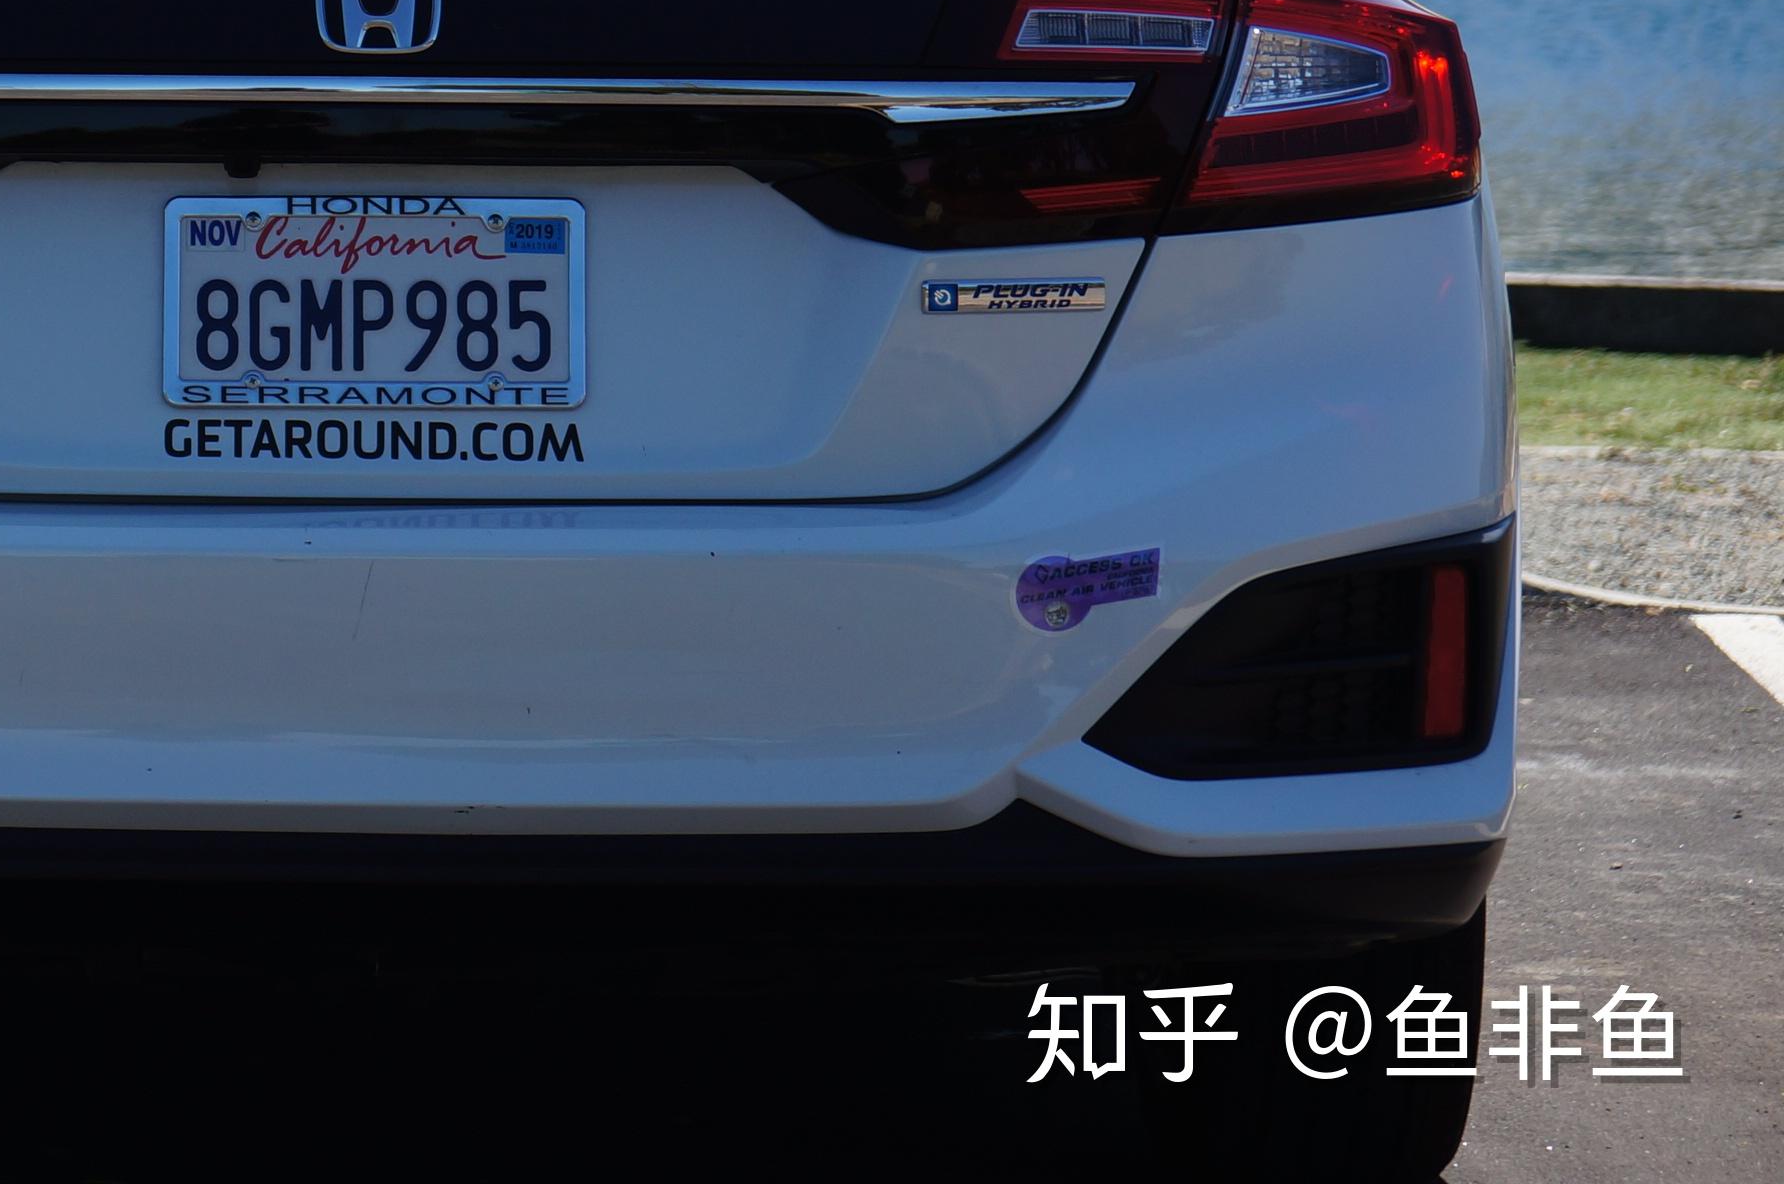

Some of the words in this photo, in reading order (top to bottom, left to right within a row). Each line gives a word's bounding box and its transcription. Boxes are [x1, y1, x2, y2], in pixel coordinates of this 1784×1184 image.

[287, 197, 465, 215] HONDA
[190, 220, 241, 246] NOV
[256, 216, 506, 274] California
[516, 224, 554, 240] 2019
[972, 283, 1088, 298] PLUG-IN
[988, 299, 1071, 310] HYBRID
[196, 279, 551, 371] 8GMP985
[181, 385, 569, 405] SERRAMONTE
[164, 419, 584, 462] GETAROUND.COM
[1049, 559, 1123, 582] ACCESS
[1130, 552, 1154, 567] OK
[1020, 588, 1066, 604] CLEAN
[1071, 584, 1094, 597] AIR
[1100, 575, 1153, 591] VEHICLE
